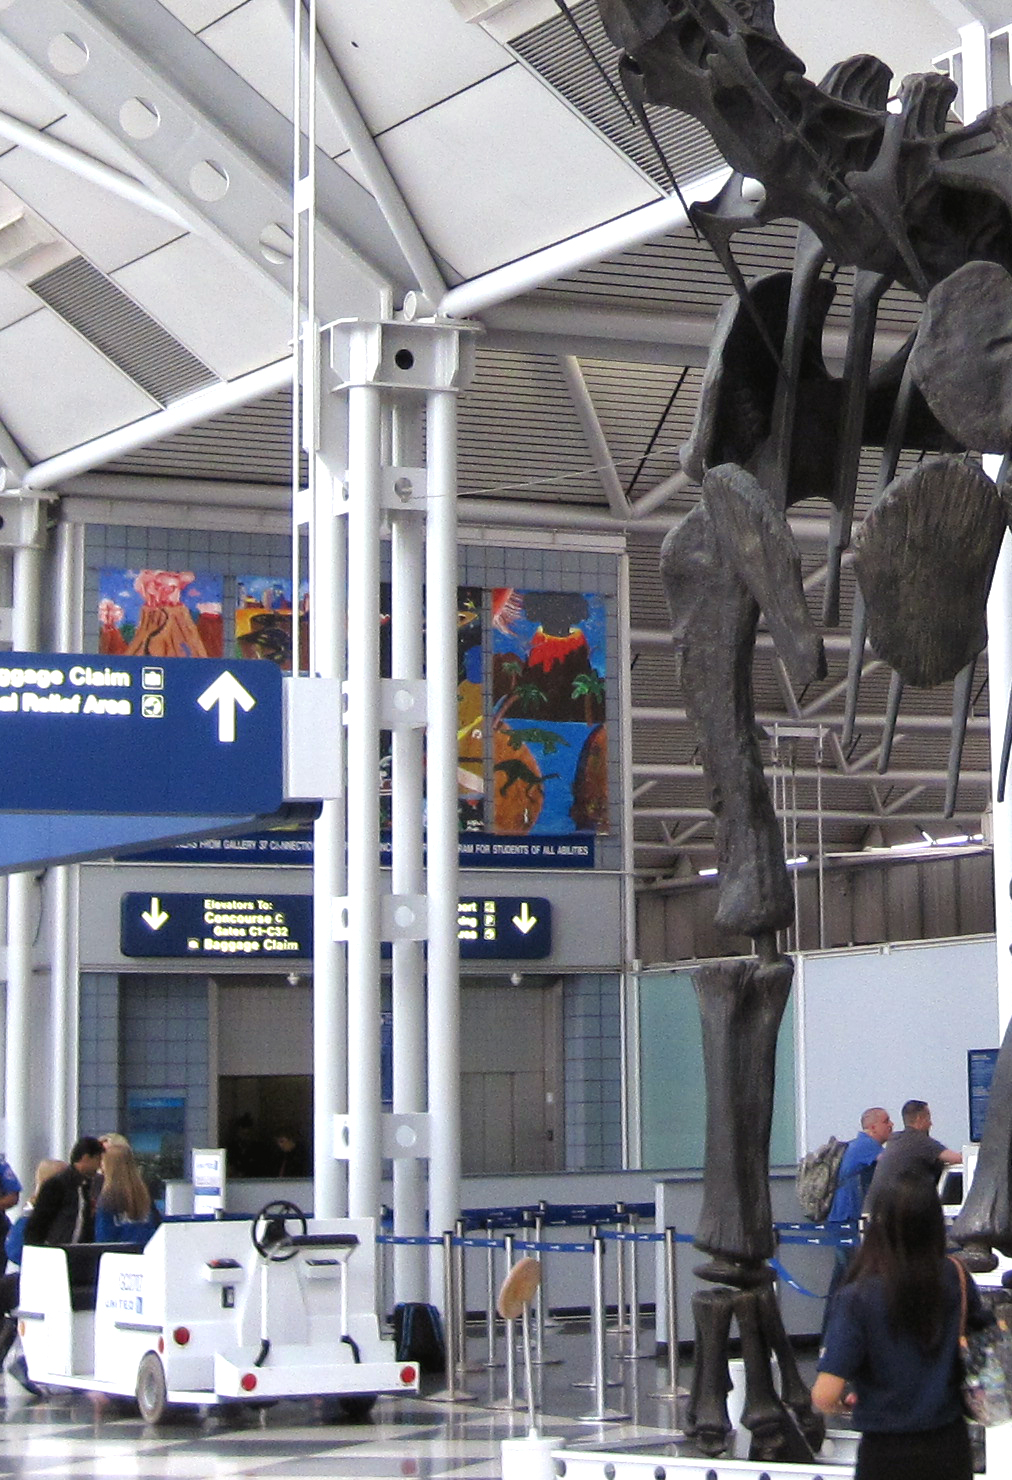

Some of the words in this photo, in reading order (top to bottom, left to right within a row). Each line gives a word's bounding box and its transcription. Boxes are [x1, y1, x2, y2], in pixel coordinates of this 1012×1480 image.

[69, 666, 131, 687] Claim
[22, 692, 81, 714] Relief
[83, 694, 132, 716] Area
[475, 844, 490, 854] FOR
[492, 844, 529, 855] STUDENTS
[530, 845, 541, 855] OF
[204, 899, 254, 910] Elevators
[257, 900, 274, 910] To:
[204, 911, 272, 924] Concourse
[213, 926, 247, 937] Gates
[248, 926, 290, 937] C1-C32
[203, 938, 260, 953] Baggage
[263, 938, 299, 951] Claim
